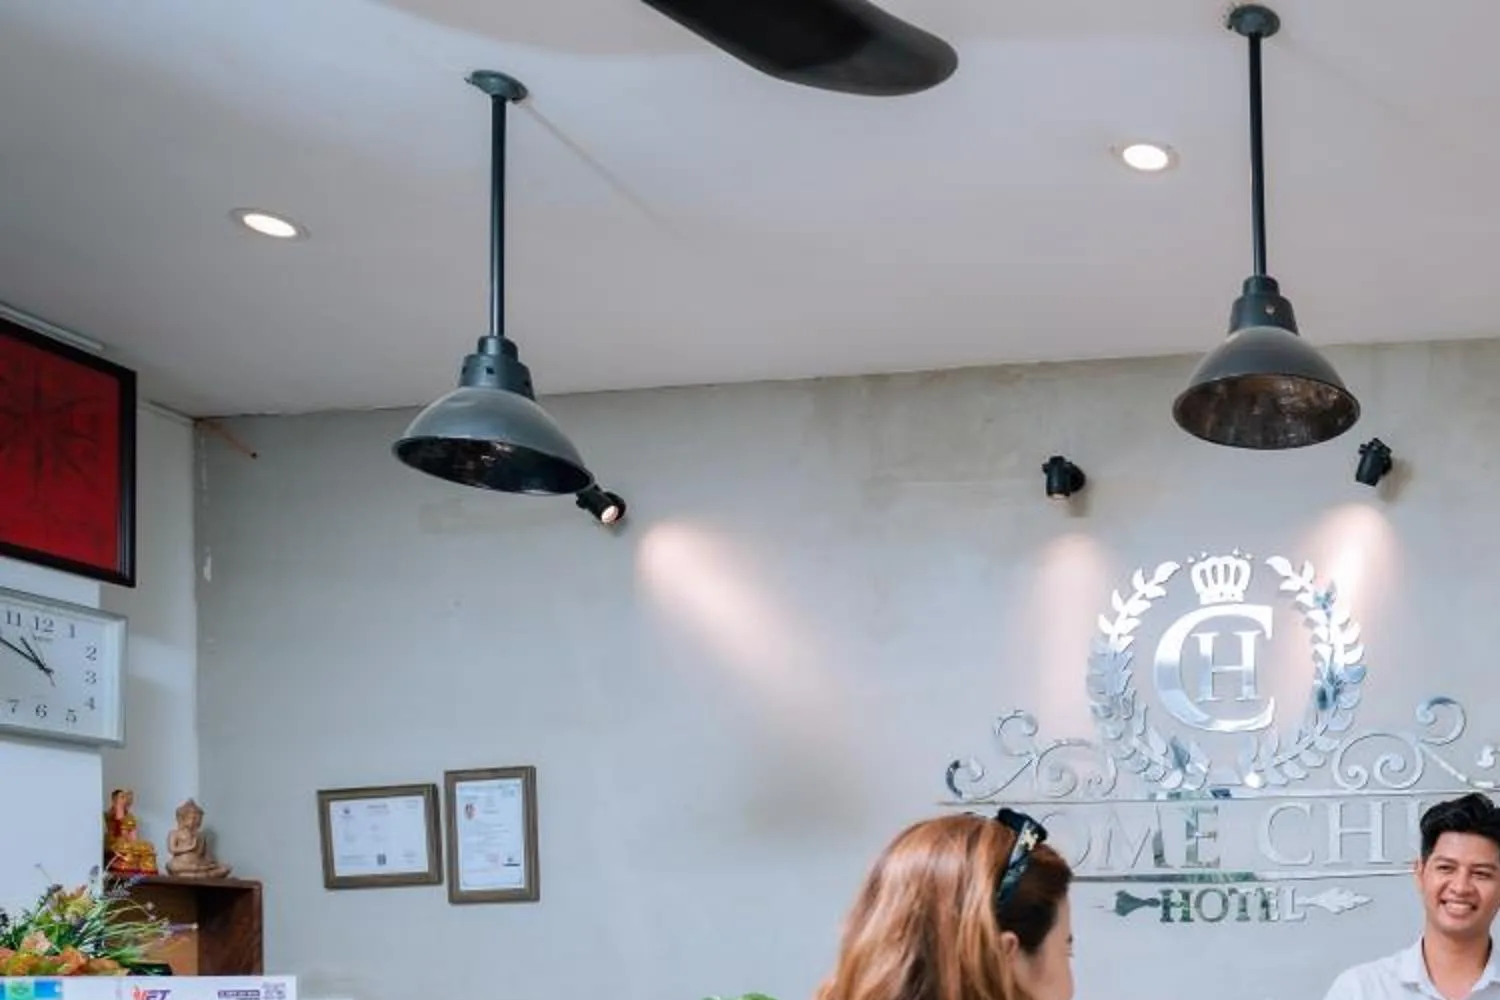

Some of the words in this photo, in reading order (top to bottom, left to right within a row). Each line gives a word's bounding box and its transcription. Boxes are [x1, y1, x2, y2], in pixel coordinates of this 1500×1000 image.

[6, 610, 21, 627] 11
[34, 615, 55, 633] 12
[69, 623, 76, 639] 1
[85, 645, 98, 661] 2
[84, 671, 98, 685] 3
[8, 698, 20, 714] 7
[35, 703, 48, 719] 6
[83, 696, 96, 711] 4
[65, 708, 77, 723] 5
[1039, 802, 1222, 870] OME
[1262, 799, 1423, 867] CHI
[1158, 885, 1307, 924] HOTEL
